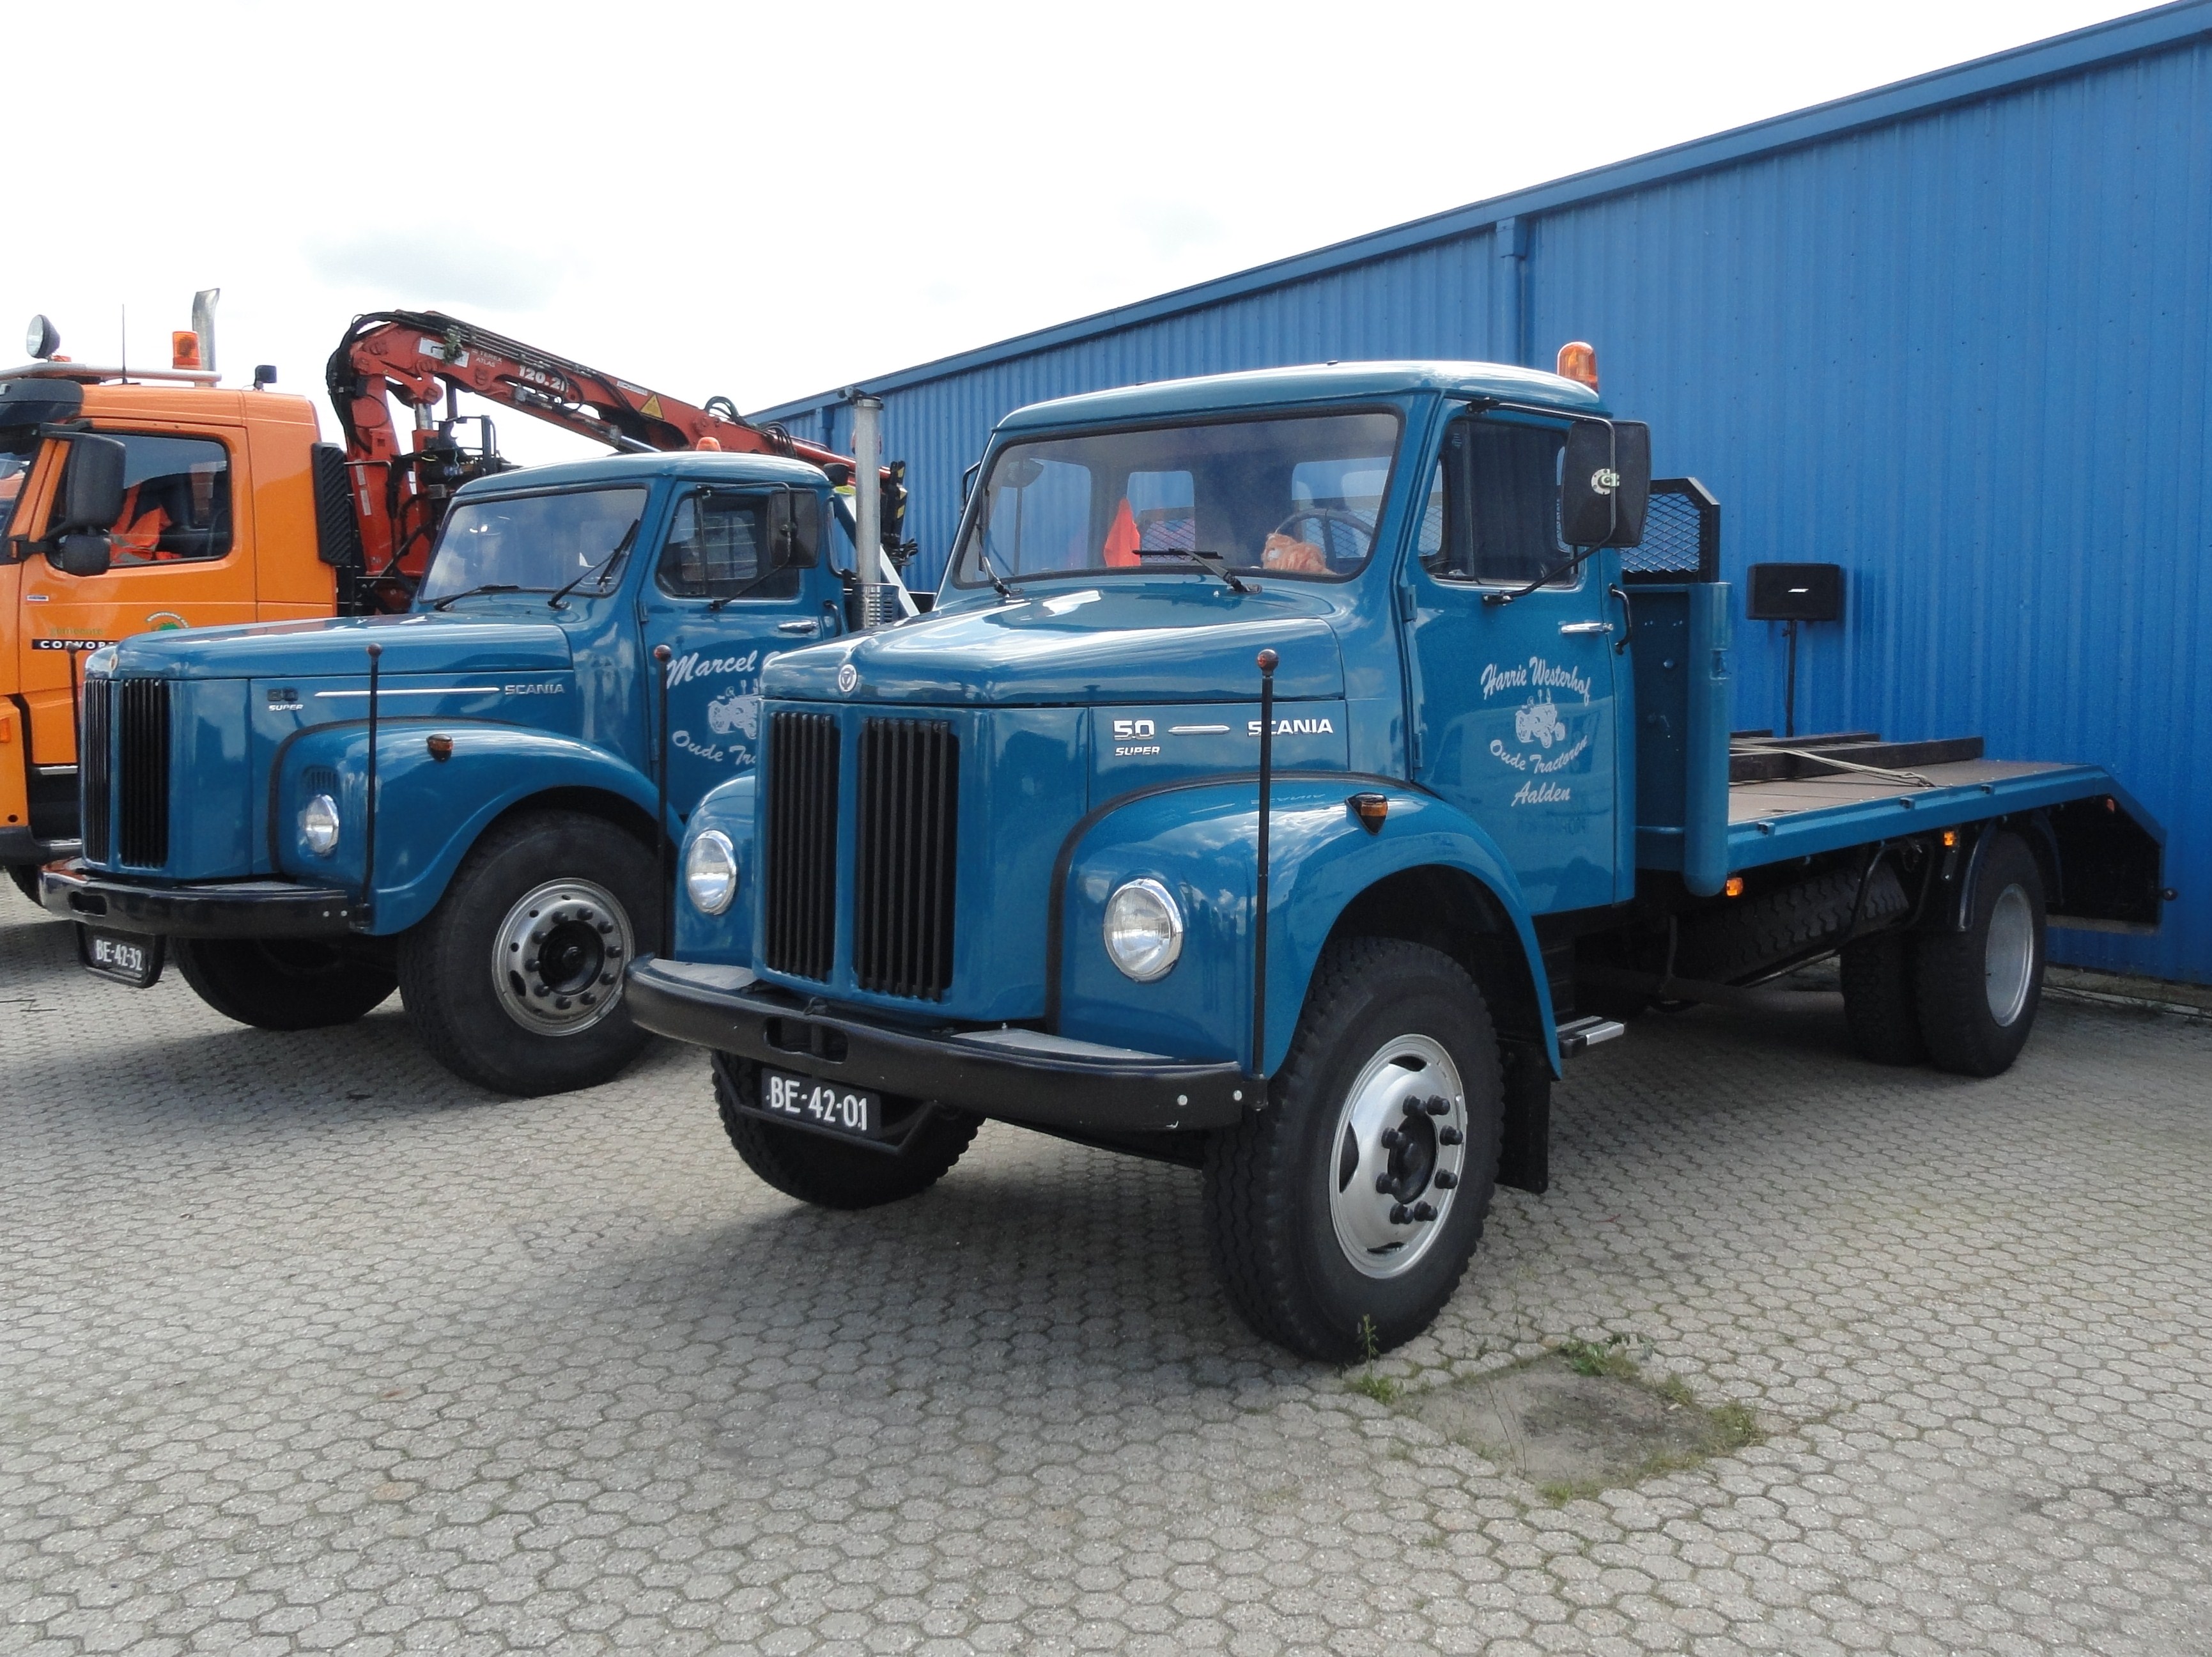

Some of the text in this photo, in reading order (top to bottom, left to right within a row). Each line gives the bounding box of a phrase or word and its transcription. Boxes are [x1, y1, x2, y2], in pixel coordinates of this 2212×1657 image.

[476, 357, 495, 368] ATLAS
[480, 350, 502, 362] TEREX
[667, 650, 758, 689] Marcel
[1480, 657, 1591, 706] Harrie Westerhof
[505, 684, 565, 695] SCANIA
[672, 730, 723, 761] Oude
[1115, 746, 1160, 756] SUPER
[1490, 735, 1588, 774] Oude Tractoren
[1511, 781, 1570, 807] Aalden
[771, 1076, 867, 1131] BE-42-01
